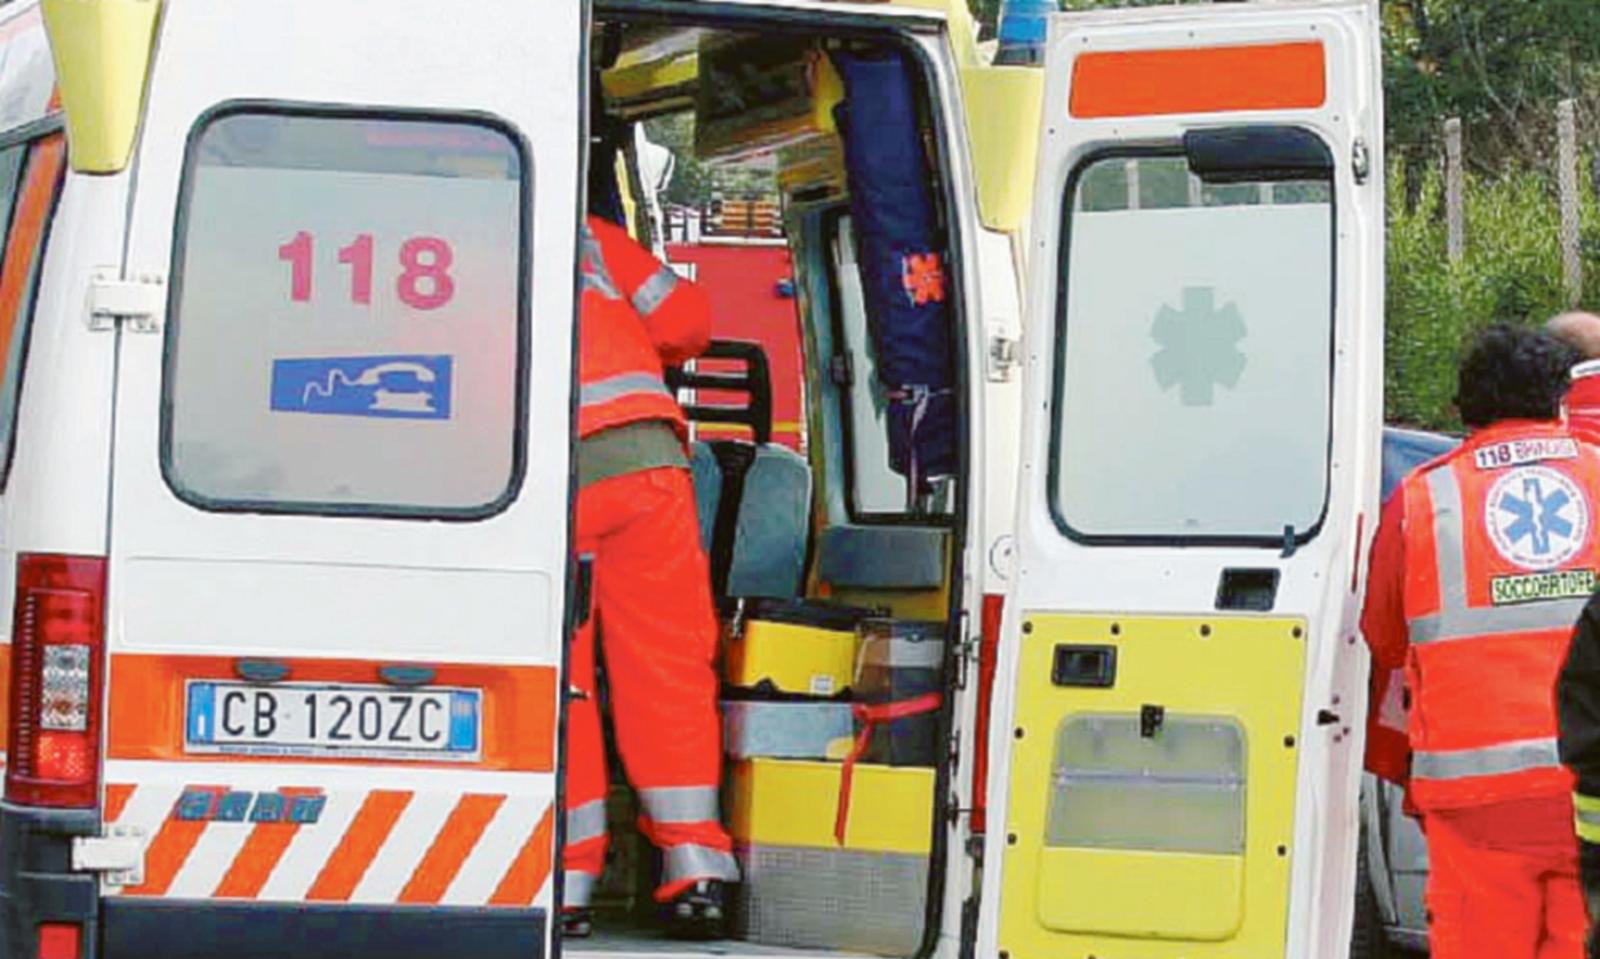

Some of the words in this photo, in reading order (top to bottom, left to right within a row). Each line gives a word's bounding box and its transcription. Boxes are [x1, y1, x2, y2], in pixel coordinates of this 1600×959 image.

[278, 231, 454, 310] 118
[1478, 445, 1511, 466] 118
[222, 691, 277, 737] CB
[305, 693, 442, 741] 120ZC
